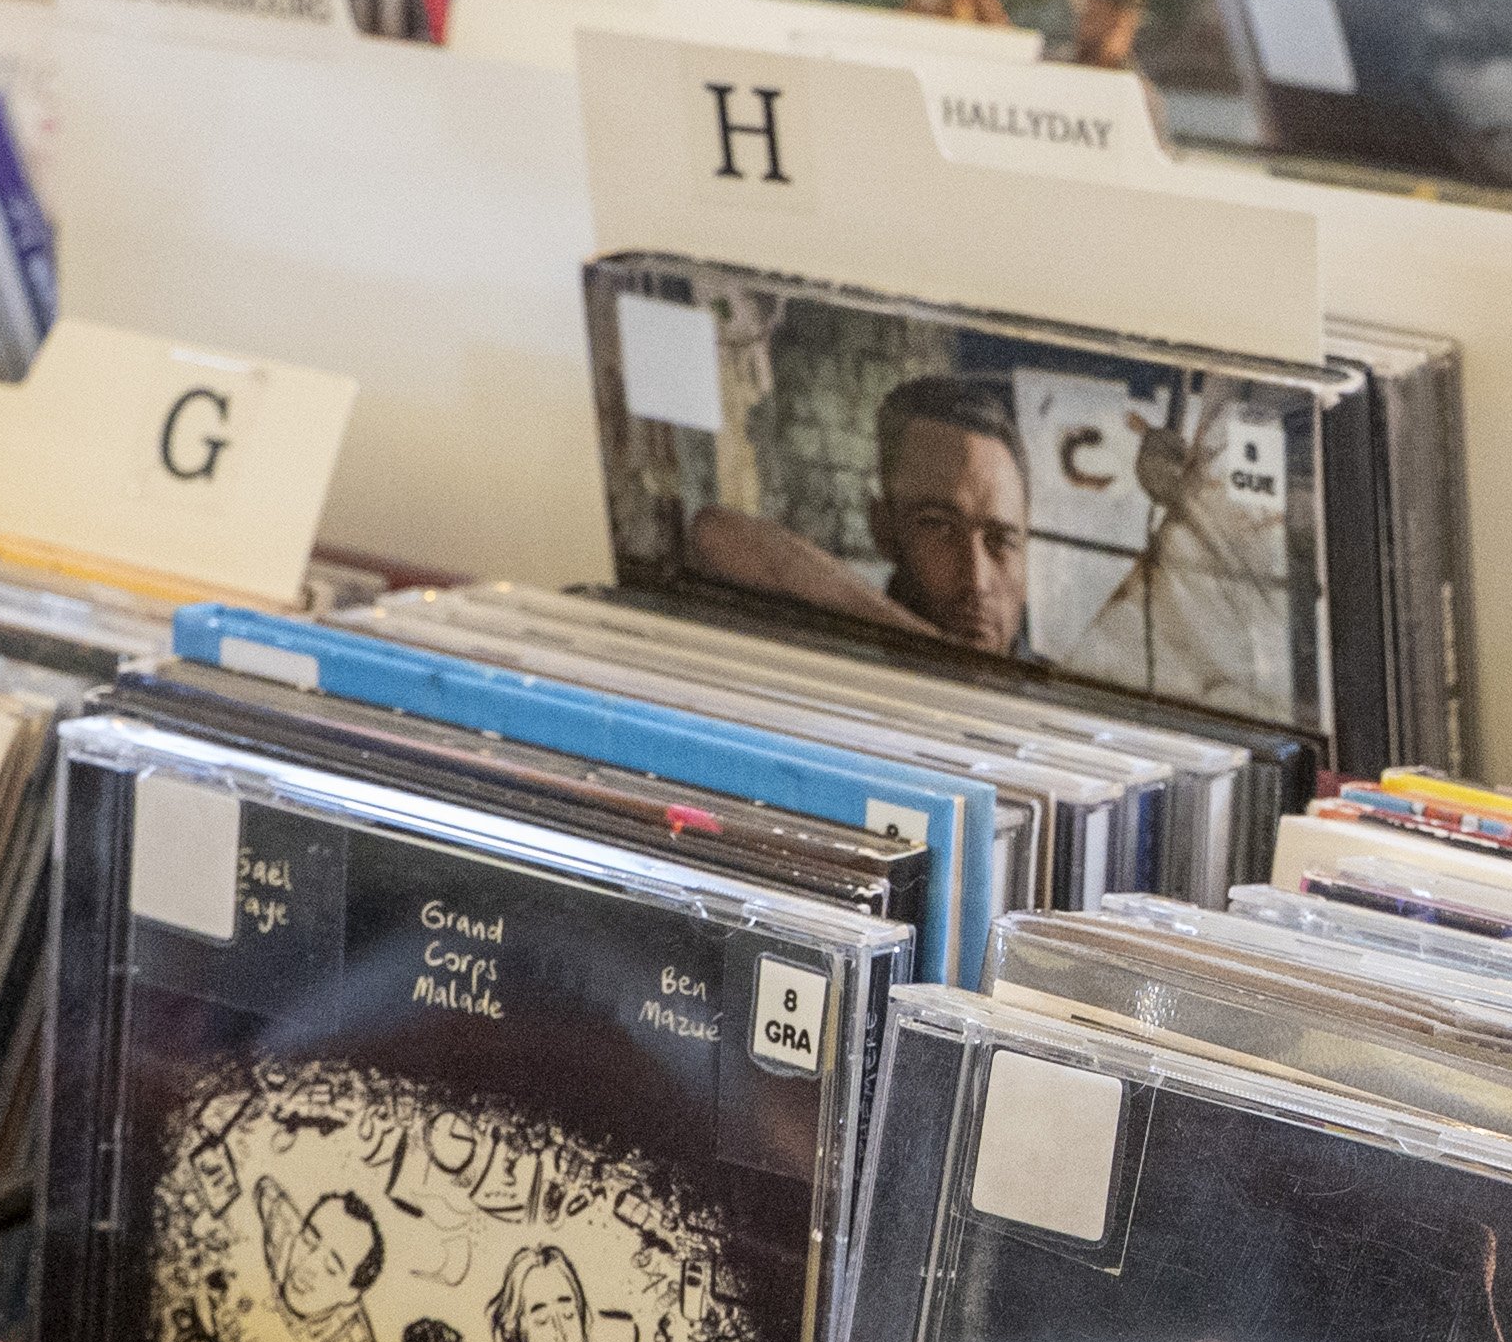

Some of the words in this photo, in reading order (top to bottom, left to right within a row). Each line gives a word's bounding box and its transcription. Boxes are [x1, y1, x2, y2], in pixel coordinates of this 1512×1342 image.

[703, 82, 793, 185] H
[941, 96, 1114, 150] HALLYDAY
[159, 386, 231, 483] G
[1230, 469, 1276, 497] GUE
[420, 899, 505, 944] Grand
[423, 939, 499, 994] Corps
[660, 964, 708, 1002] Ben
[411, 975, 505, 1020] Malade
[783, 988, 799, 1014] 8
[639, 999, 725, 1044] Mazué
[763, 1019, 813, 1055] GRA
